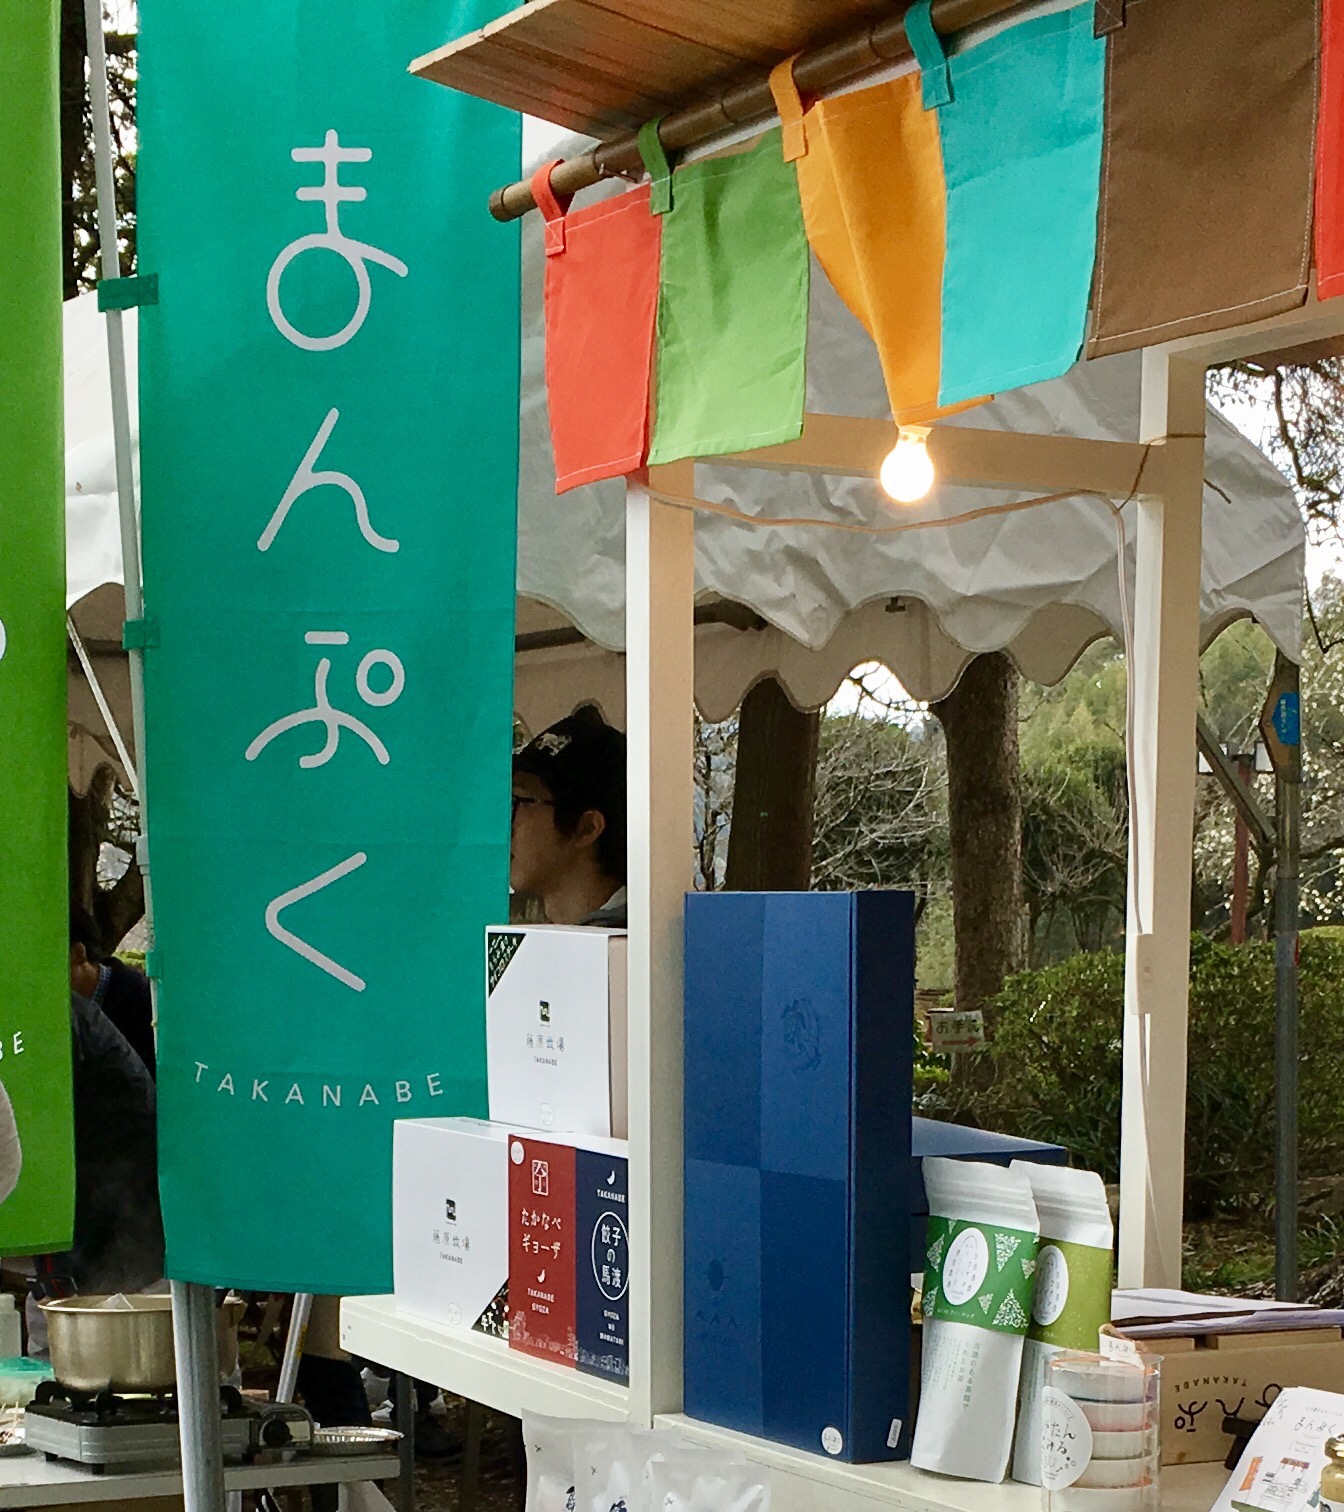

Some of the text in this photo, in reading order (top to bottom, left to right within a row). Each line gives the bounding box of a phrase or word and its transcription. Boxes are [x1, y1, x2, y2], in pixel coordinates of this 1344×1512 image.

[245, 128, 410, 992] まんぷく
[194, 1060, 446, 1109] TAKANABE
[596, 1188, 626, 1203] TAKANABE
[520, 1207, 562, 1231] たかなべ
[521, 1233, 562, 1260] ギョーザ
[600, 1223, 622, 1247] 餃子
[600, 1264, 622, 1289] 馬渡
[527, 1287, 555, 1303] TAKANABE
[531, 1302, 551, 1315] GYOZA
